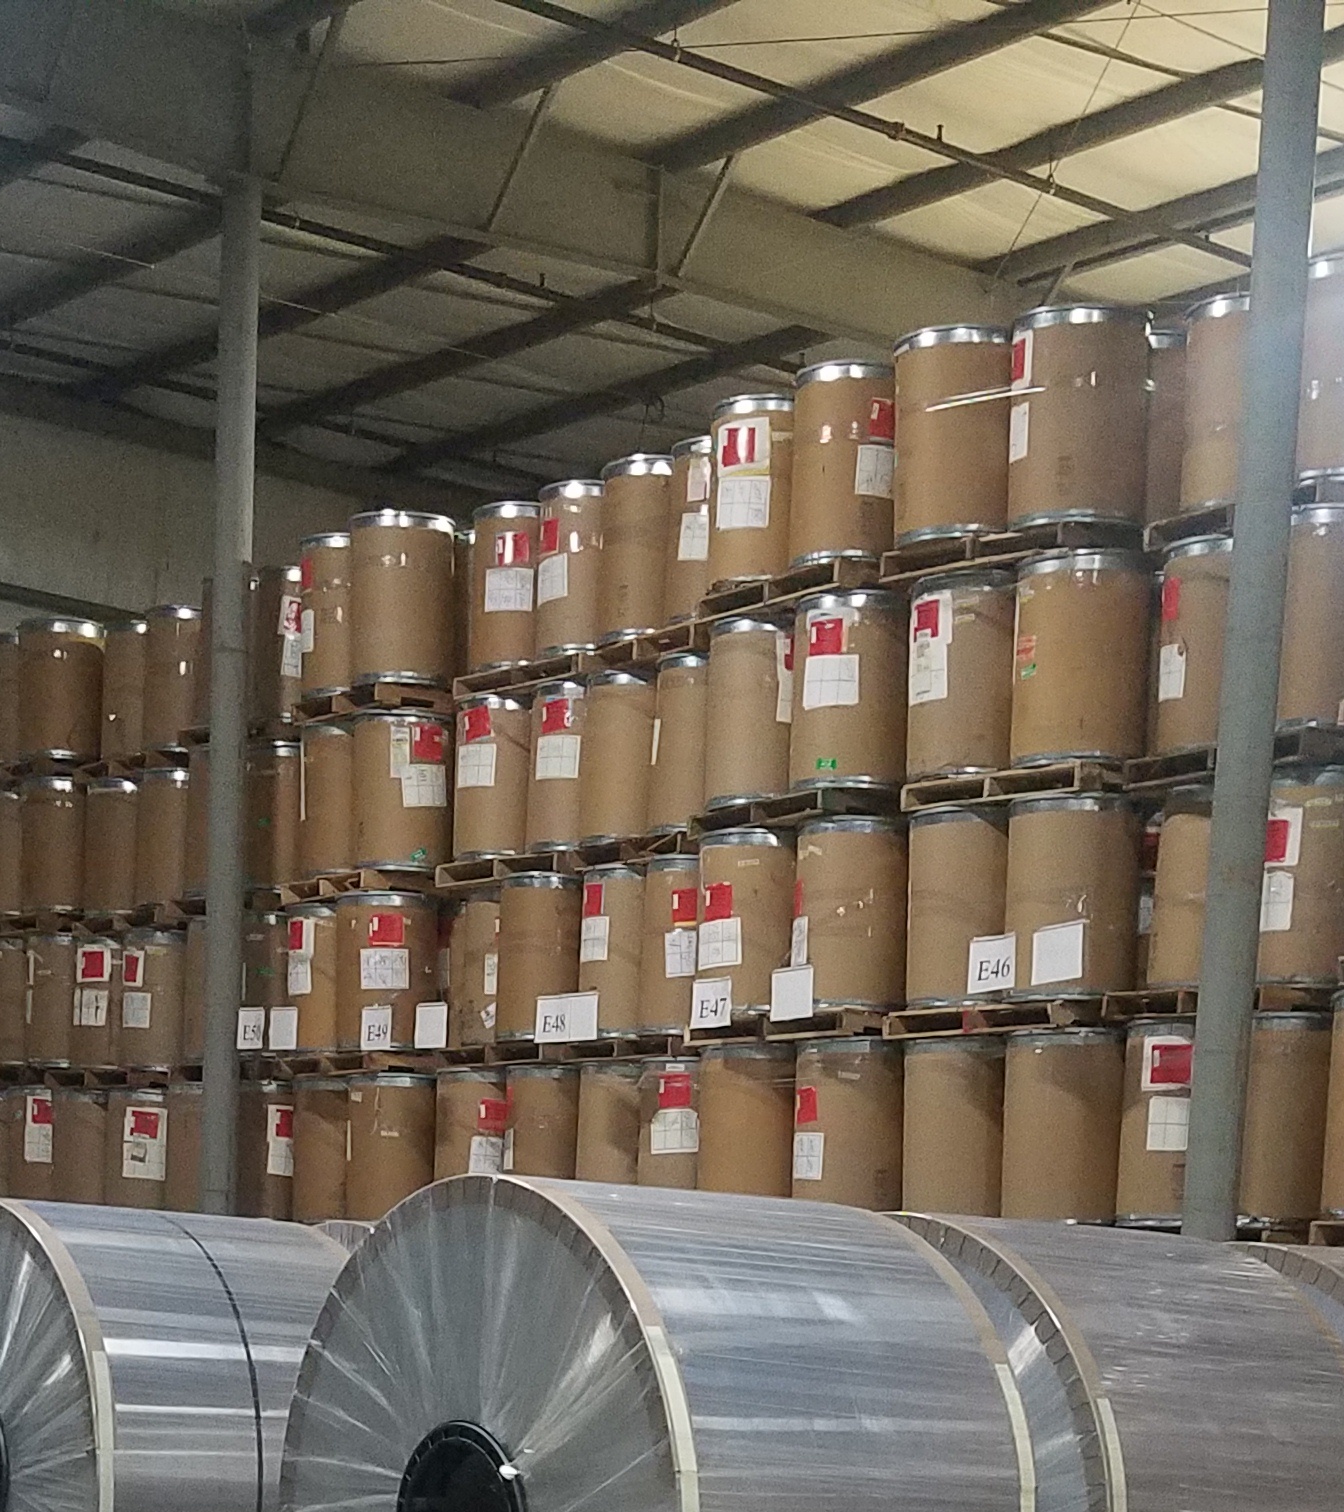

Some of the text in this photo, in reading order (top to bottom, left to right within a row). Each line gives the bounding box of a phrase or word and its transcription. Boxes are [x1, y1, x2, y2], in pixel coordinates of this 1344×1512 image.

[977, 956, 1010, 981] E46
[699, 997, 727, 1018] E47
[367, 1024, 388, 1042] E49
[542, 1014, 566, 1033] E48
